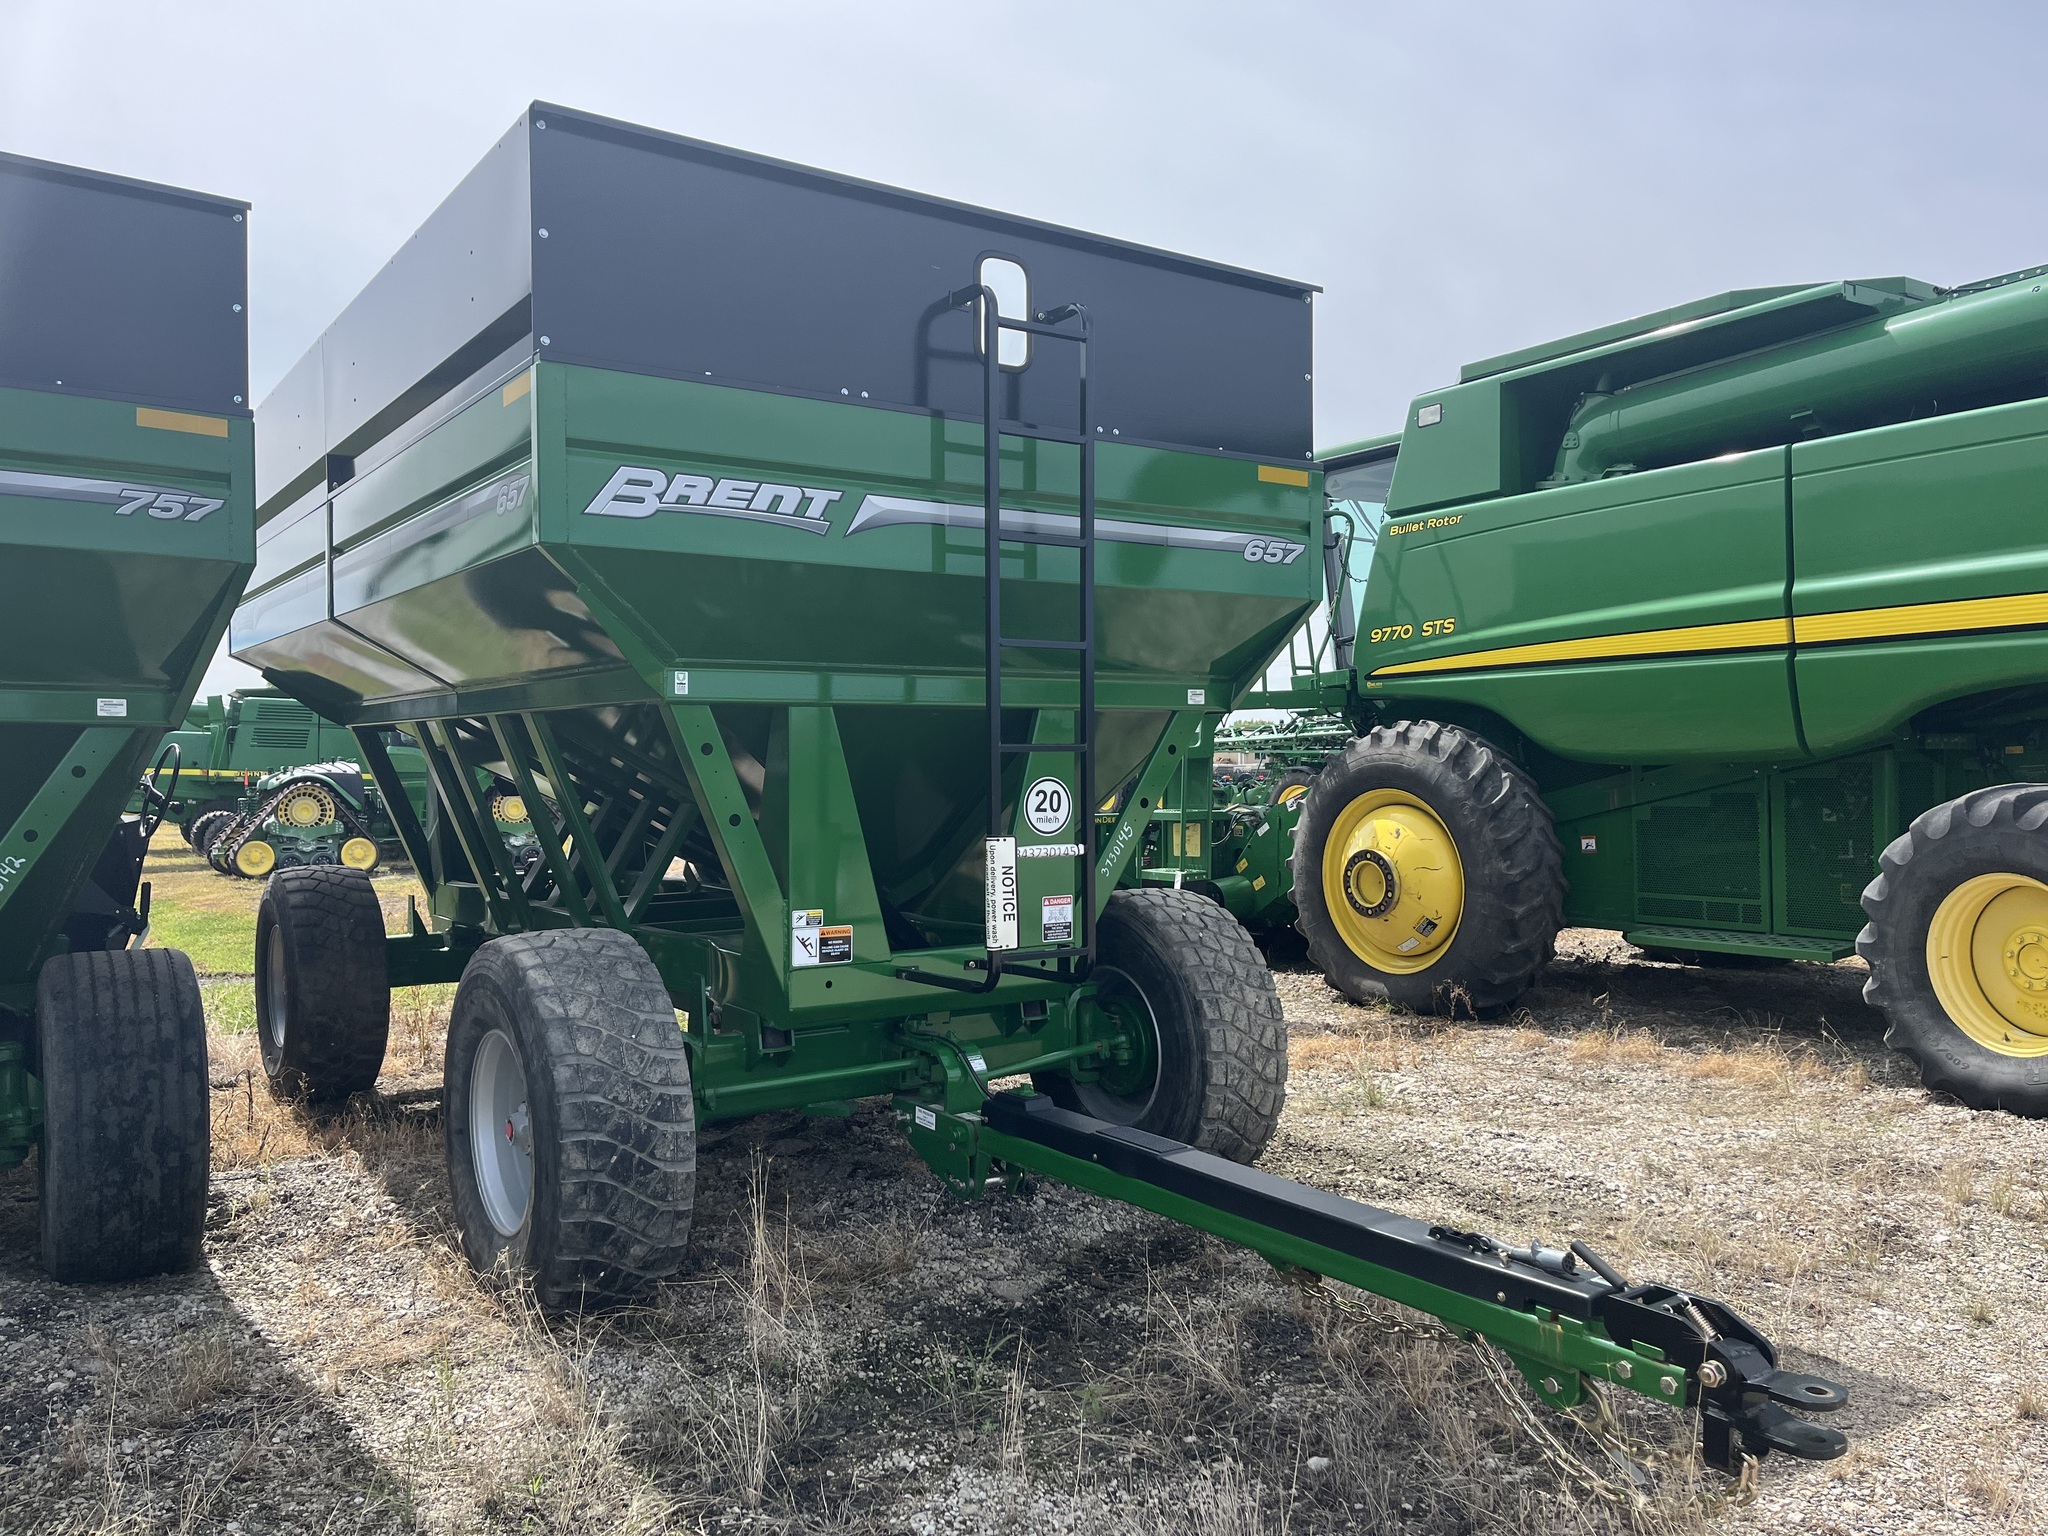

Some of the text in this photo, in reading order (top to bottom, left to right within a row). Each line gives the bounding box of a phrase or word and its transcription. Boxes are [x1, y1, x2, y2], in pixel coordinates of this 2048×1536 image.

[114, 488, 225, 522] 757
[496, 474, 530, 516] 657
[582, 464, 846, 536] BRENT
[1389, 513, 1464, 536] Bullet Rotor
[1243, 538, 1306, 565] 657
[1370, 617, 1456, 643] 9770 STS
[1034, 789, 1062, 813] 20
[1036, 815, 1060, 824] mile/h
[1100, 821, 1133, 877] 3730145
[989, 866, 998, 898] delivery,
[1001, 865, 1016, 922] NOTICE
[1049, 897, 1071, 905] DANGER
[826, 928, 851, 936] WARNING
[991, 924, 1000, 944] wash
